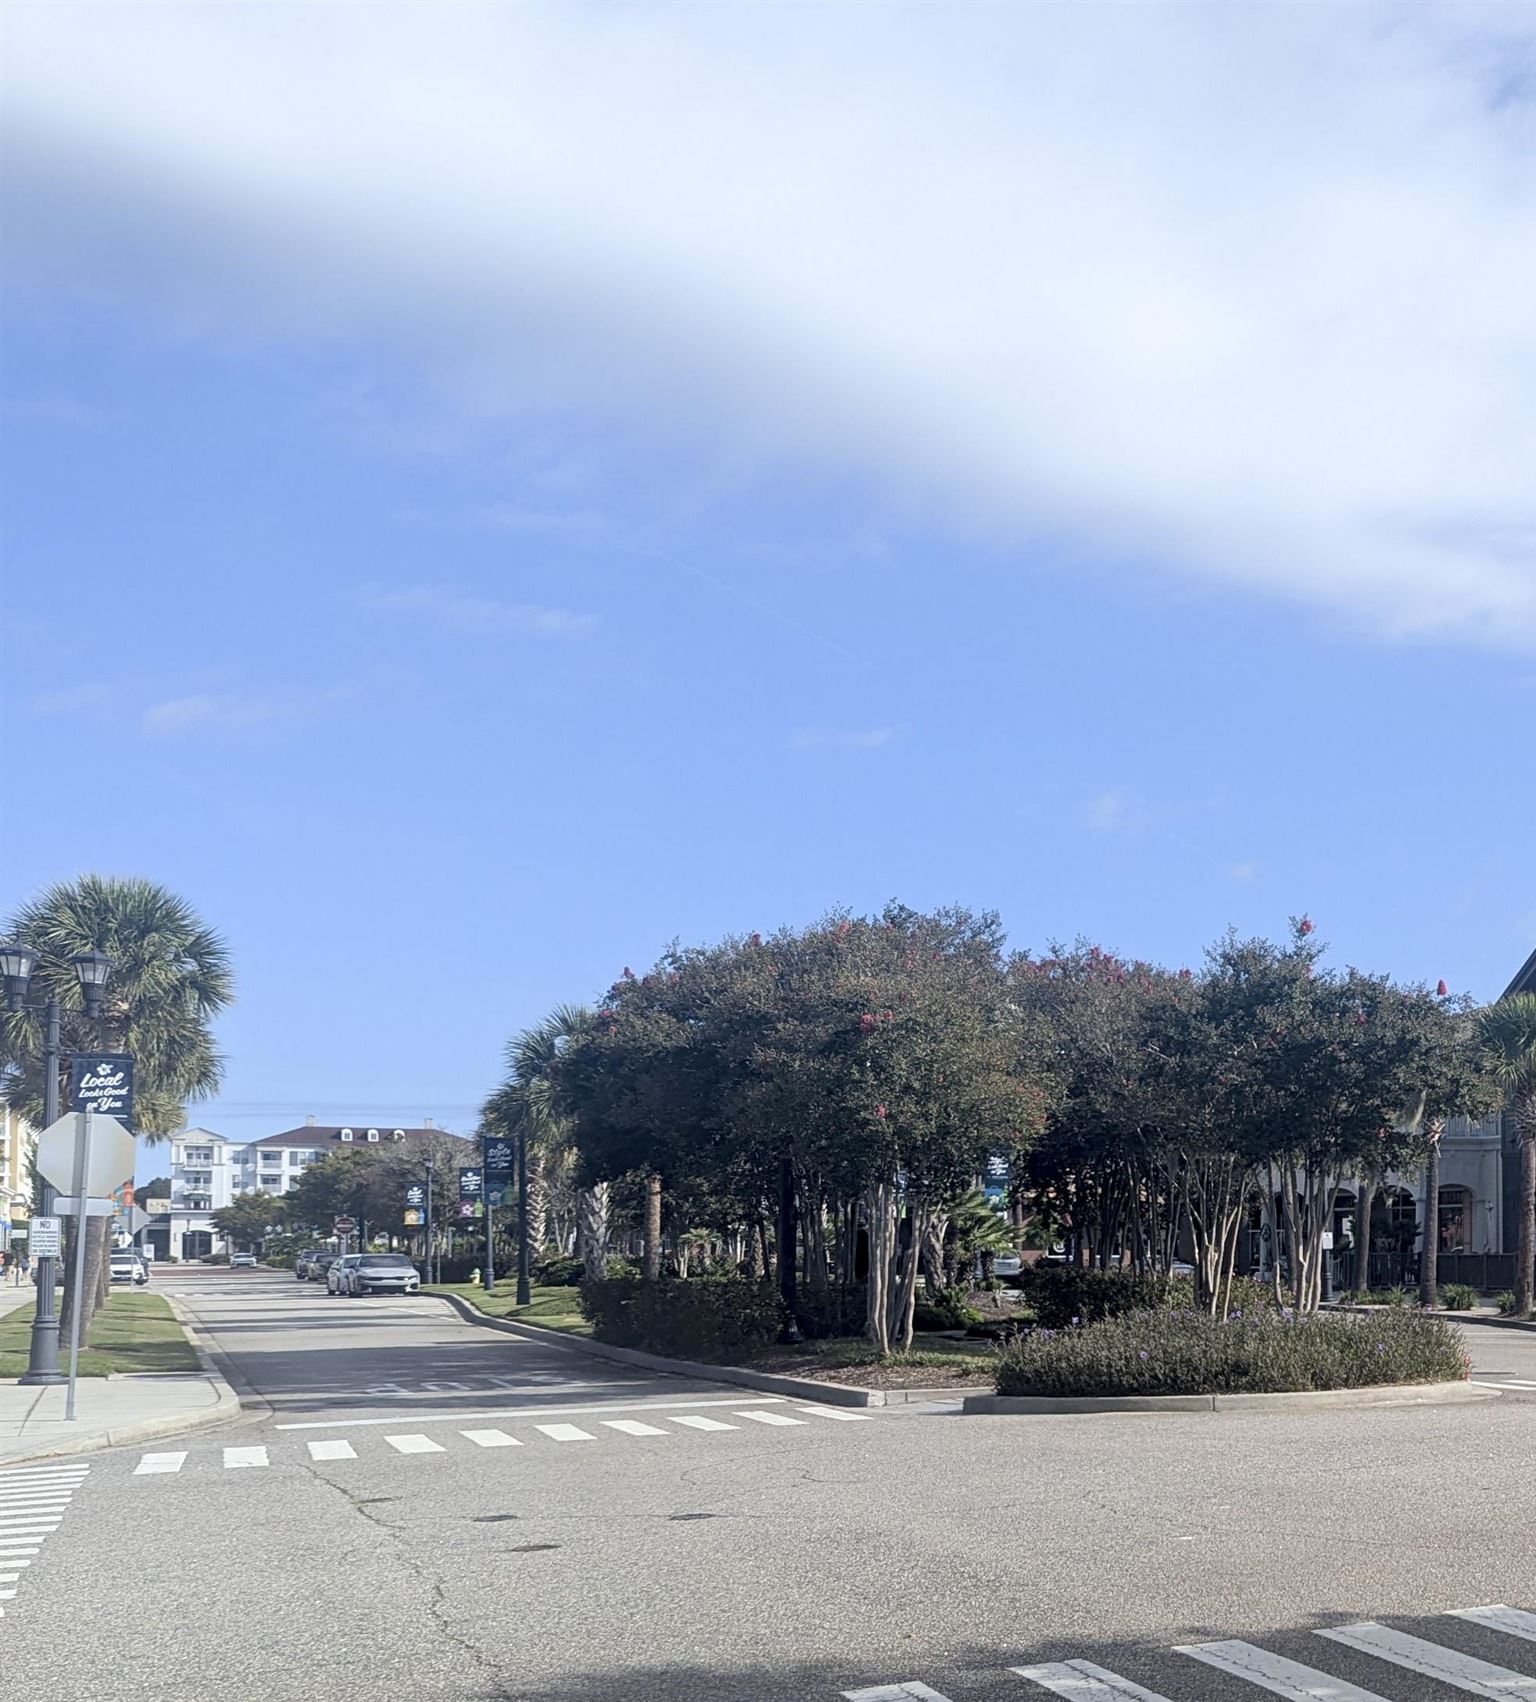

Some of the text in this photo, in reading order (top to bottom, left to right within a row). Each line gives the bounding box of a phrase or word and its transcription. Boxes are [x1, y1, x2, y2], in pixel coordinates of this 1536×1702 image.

[80, 1072, 124, 1088] Local
[104, 1086, 129, 1096] Good
[98, 1097, 123, 1111] You
[40, 1221, 51, 1229] NO
